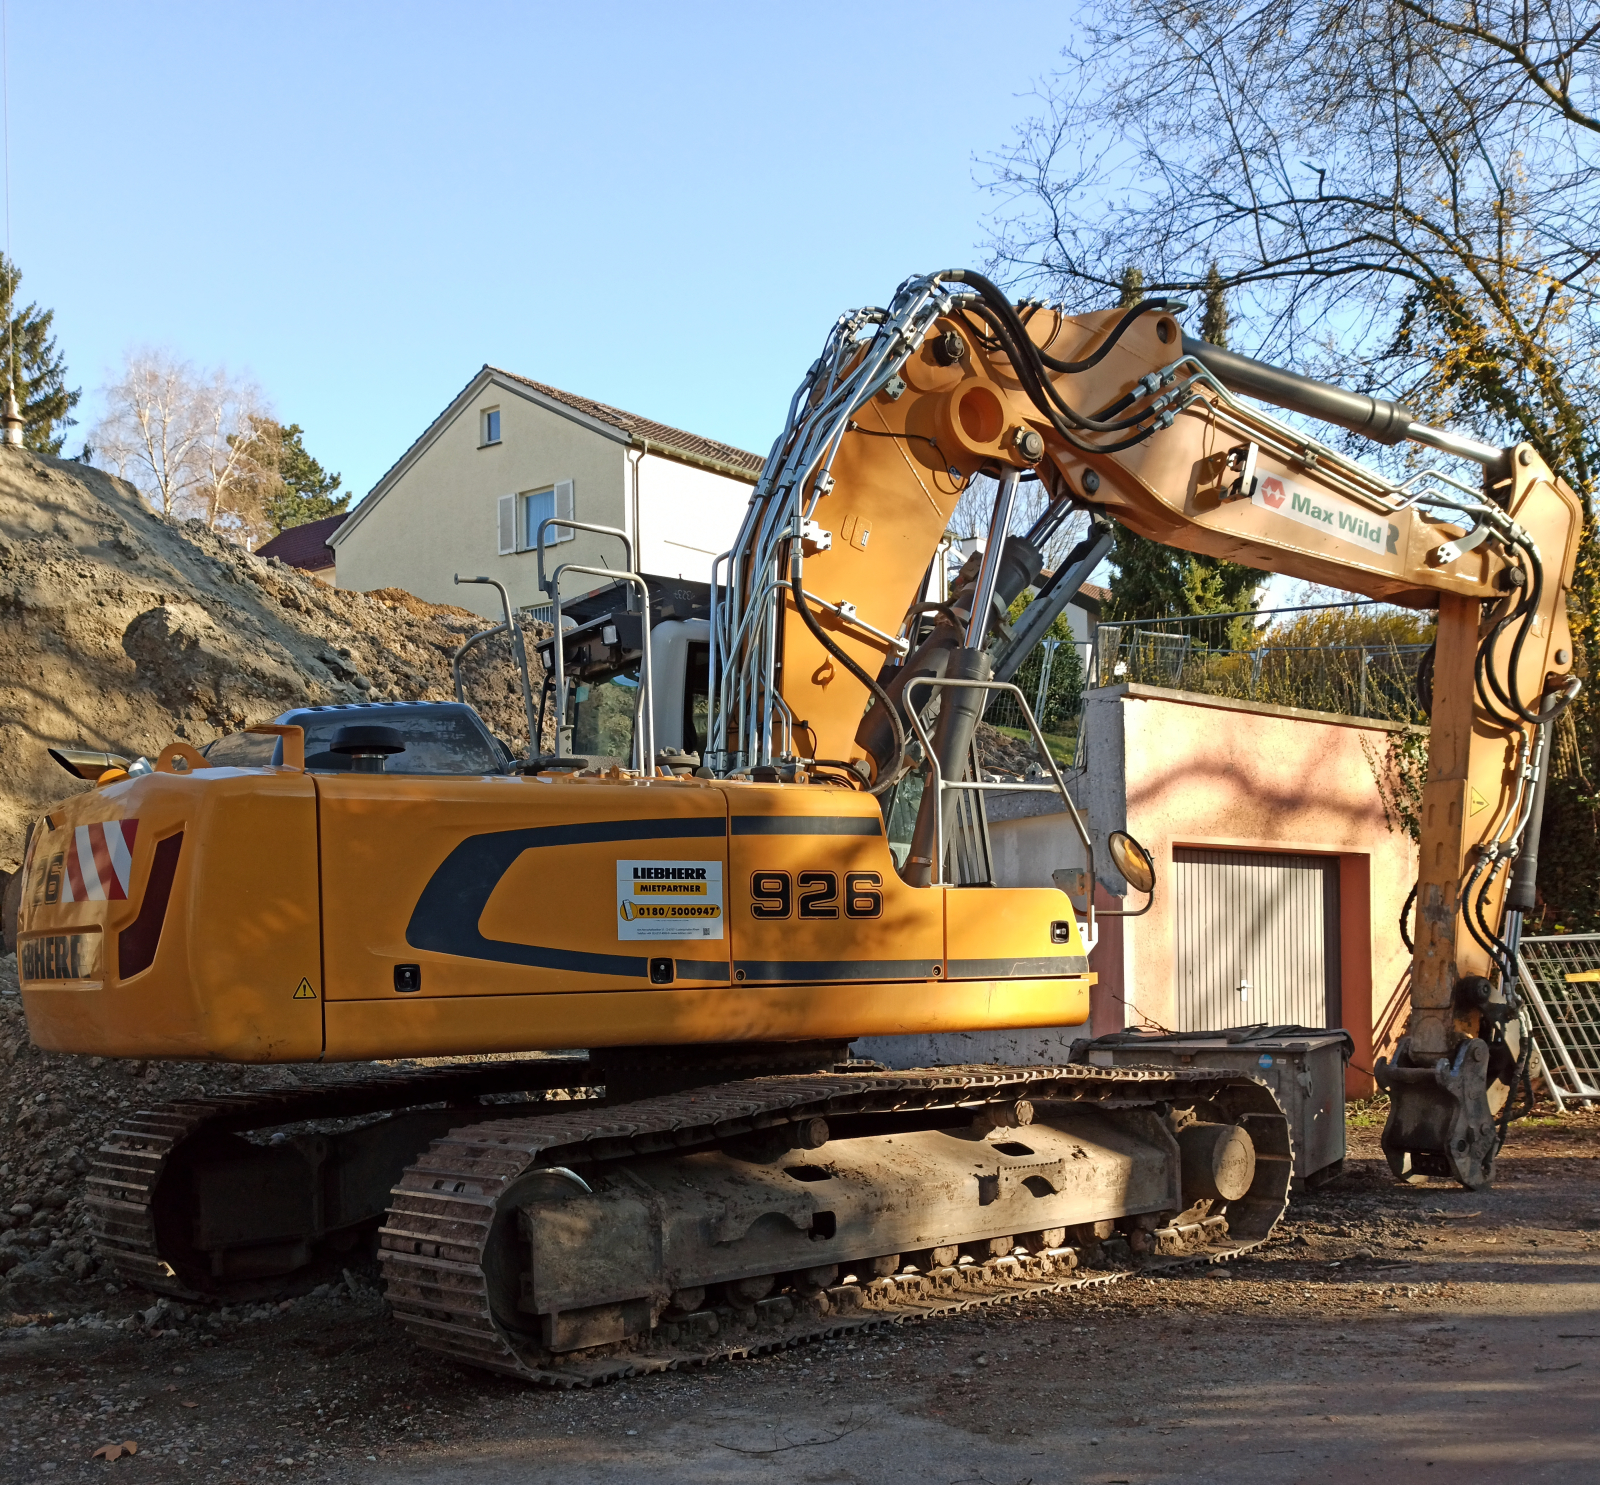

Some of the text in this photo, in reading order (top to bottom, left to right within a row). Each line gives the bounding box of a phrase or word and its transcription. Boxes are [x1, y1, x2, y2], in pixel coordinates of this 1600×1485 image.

[1291, 492, 1382, 544] Max Wild
[633, 867, 707, 880] LIEBHERR
[640, 884, 701, 893] MIETPARTNER
[750, 869, 883, 920] 926
